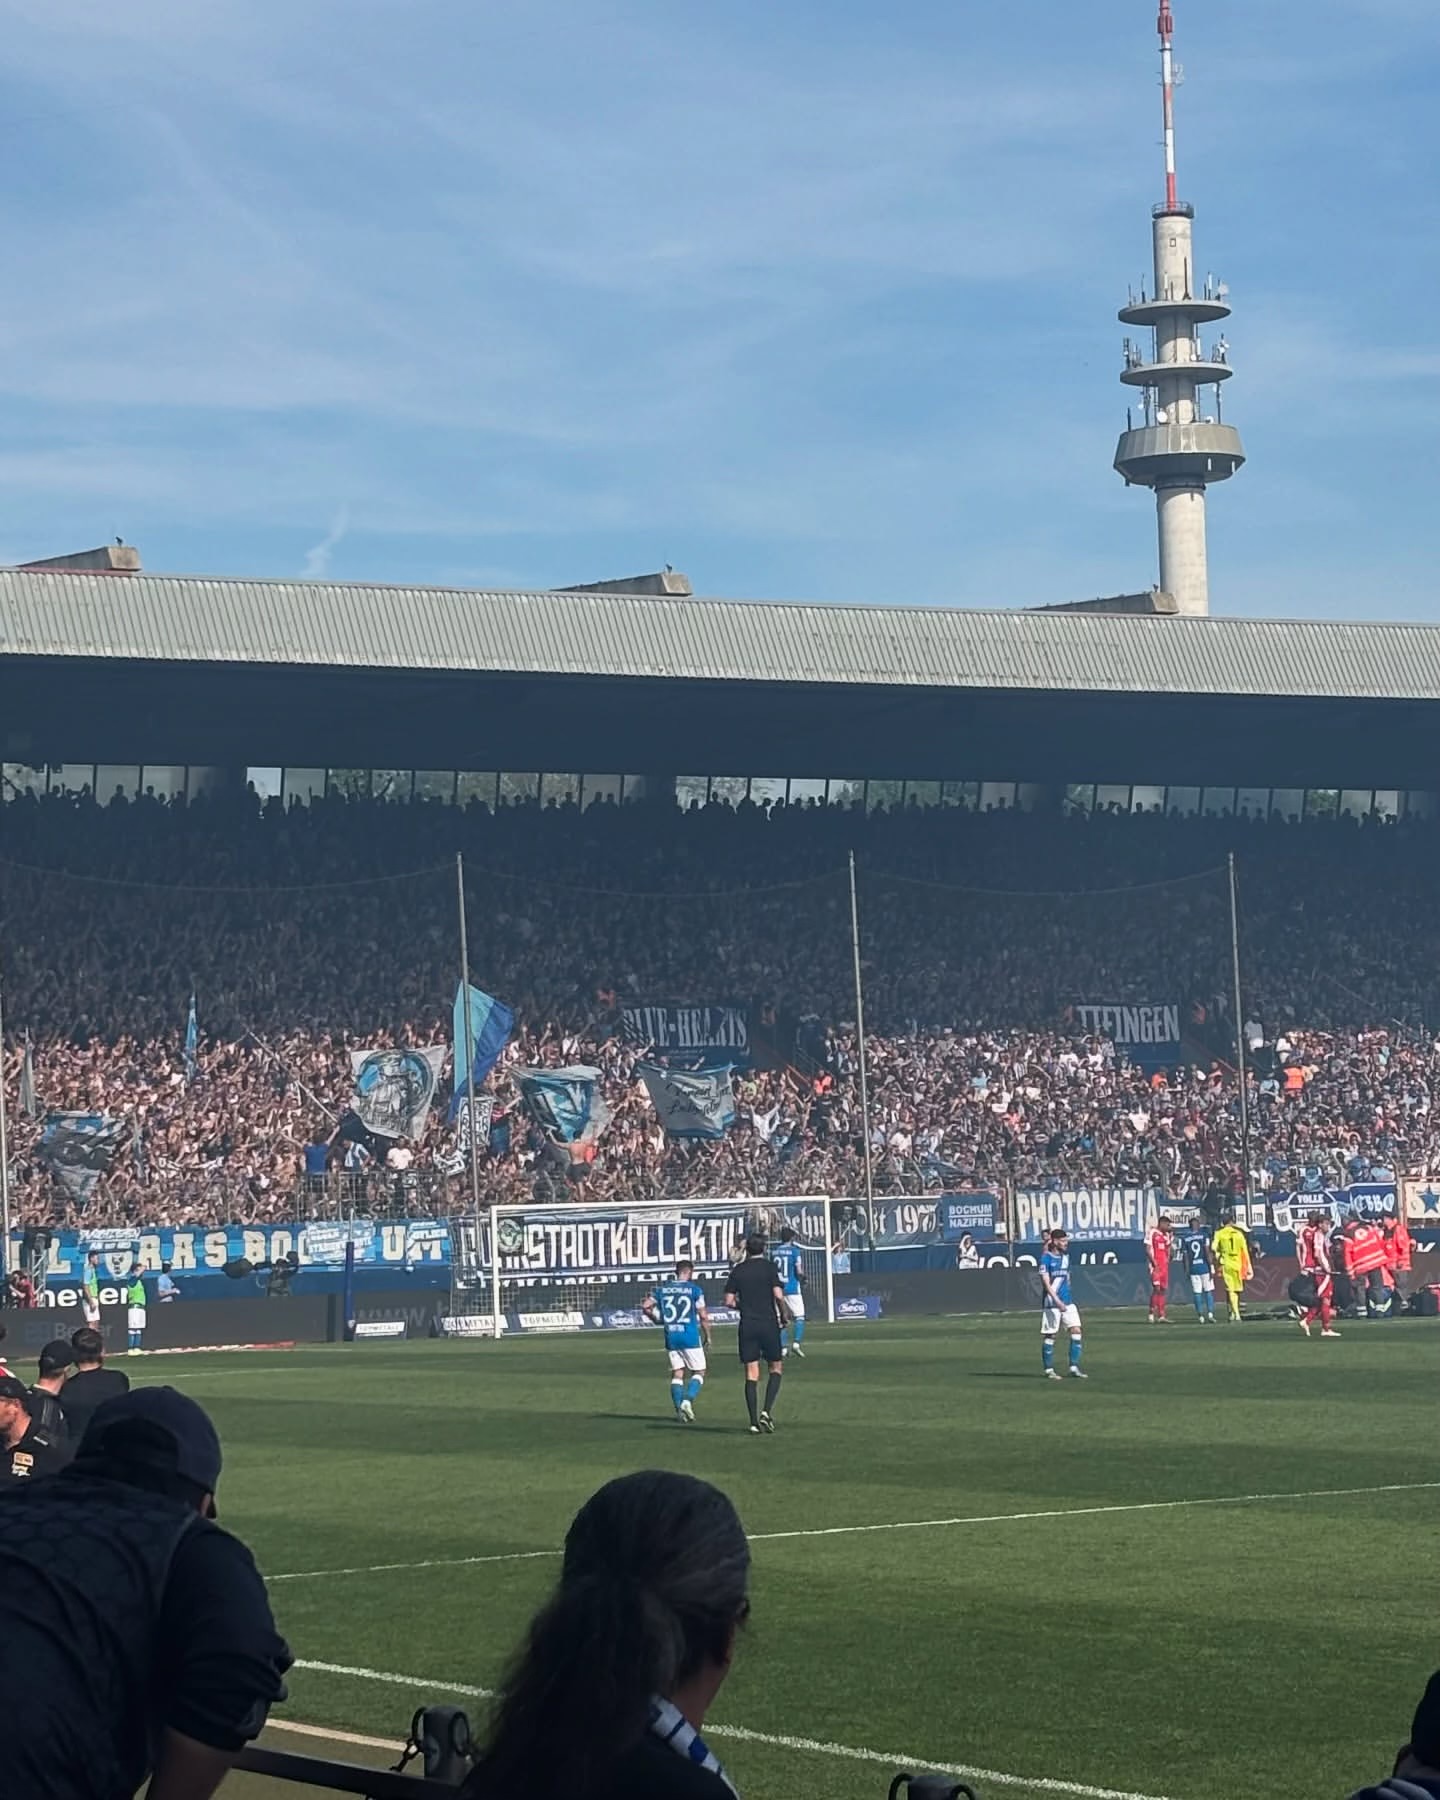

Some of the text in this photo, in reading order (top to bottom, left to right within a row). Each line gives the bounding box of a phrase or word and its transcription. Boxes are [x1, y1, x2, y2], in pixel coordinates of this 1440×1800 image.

[949, 1204, 993, 1215] BOCHUM
[1016, 1188, 1158, 1240] PHOTOMAFIA
[949, 1217, 993, 1228] NAZIFREI
[1191, 1241, 1201, 1259] 9
[662, 1295, 692, 1323] 32
